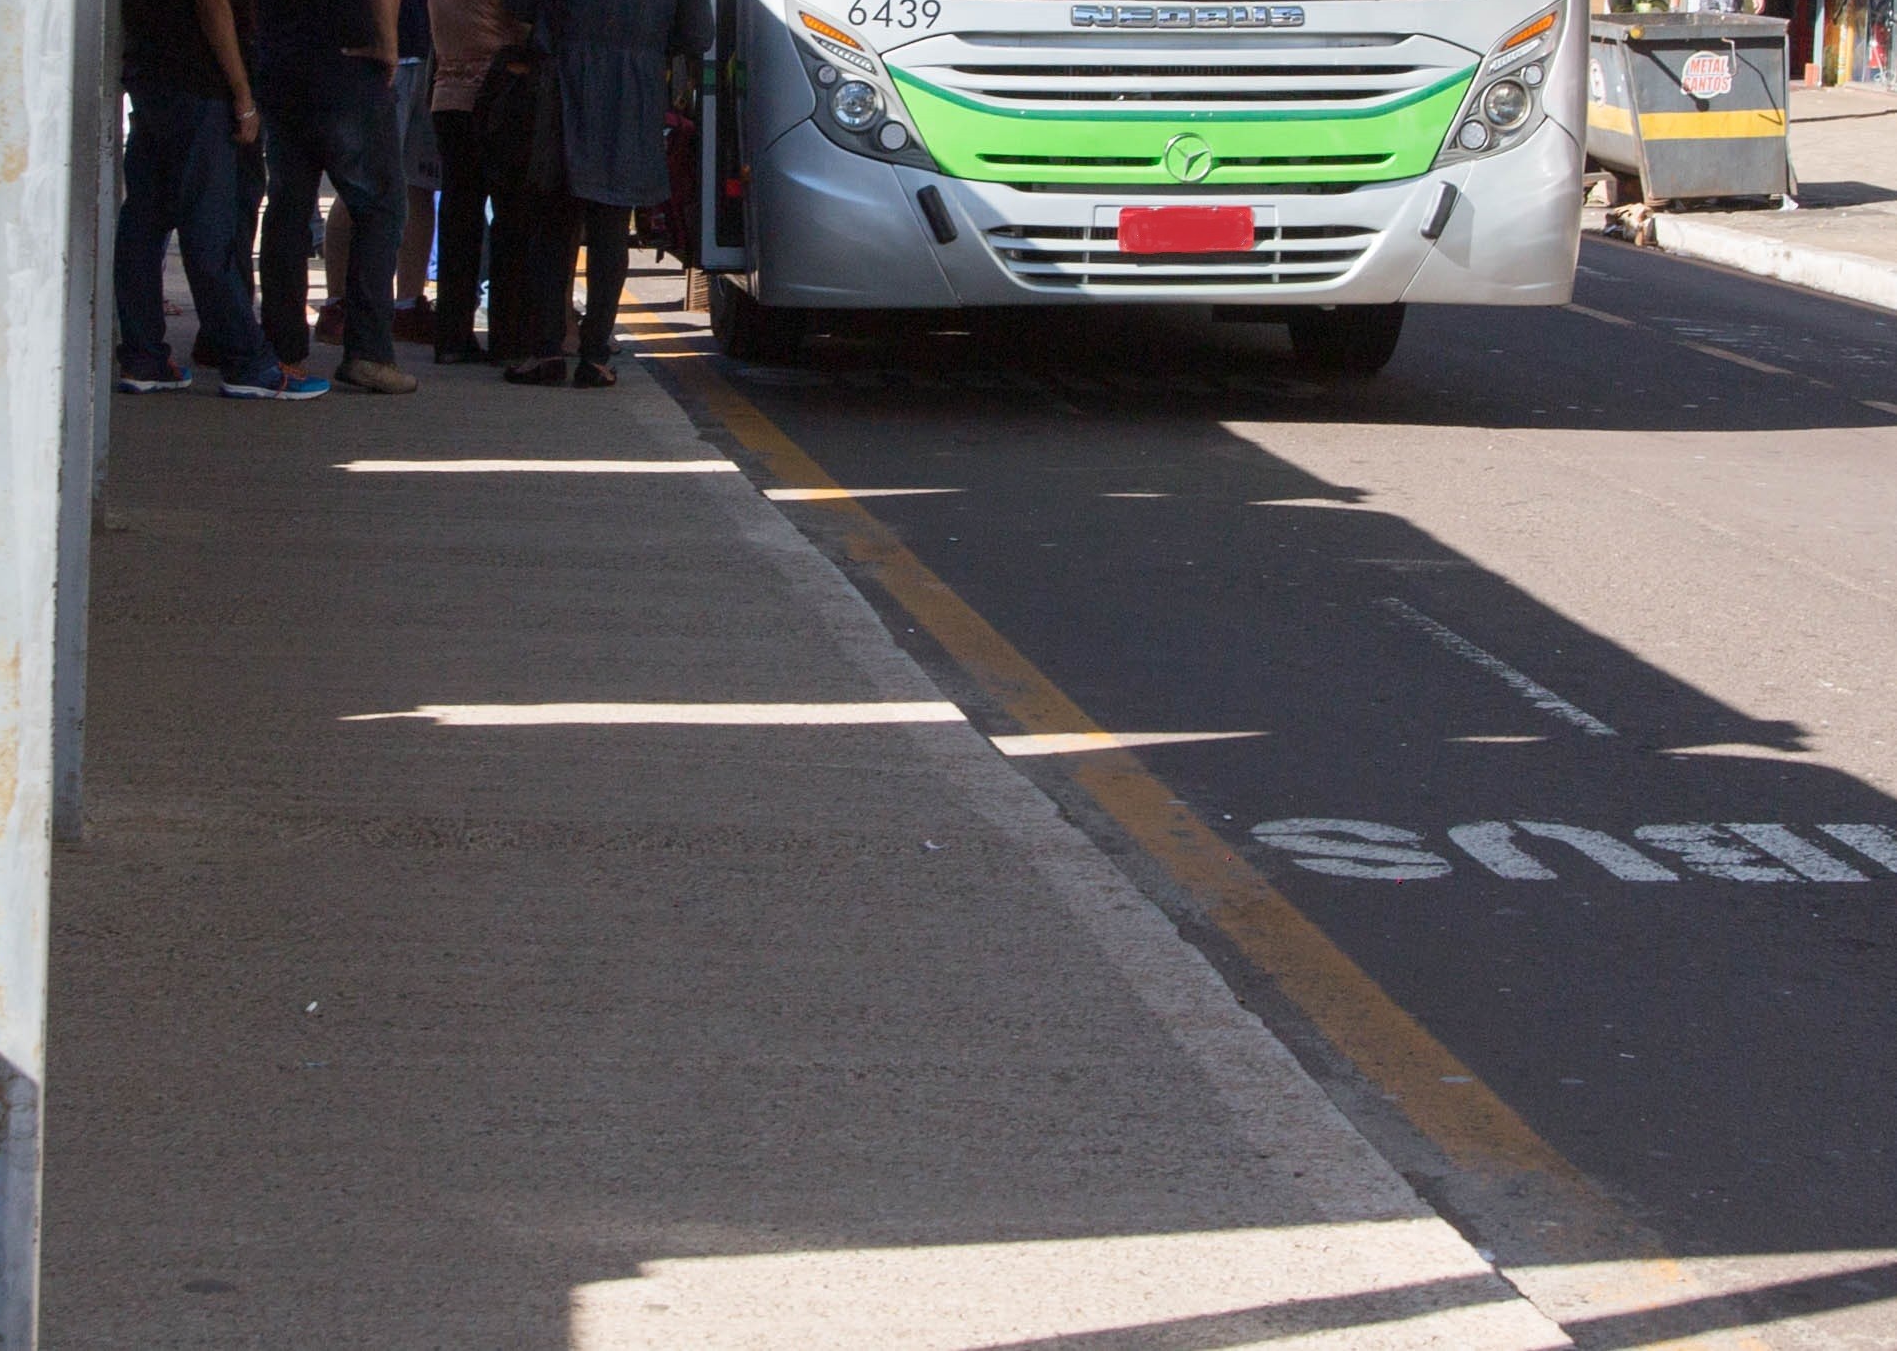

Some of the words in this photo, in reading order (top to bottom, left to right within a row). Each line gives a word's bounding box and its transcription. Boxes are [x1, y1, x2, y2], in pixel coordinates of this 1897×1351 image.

[1071, 5, 1305, 28] NEOBUS
[1690, 58, 1728, 74] METAL
[1684, 75, 1731, 92] SANTOS
